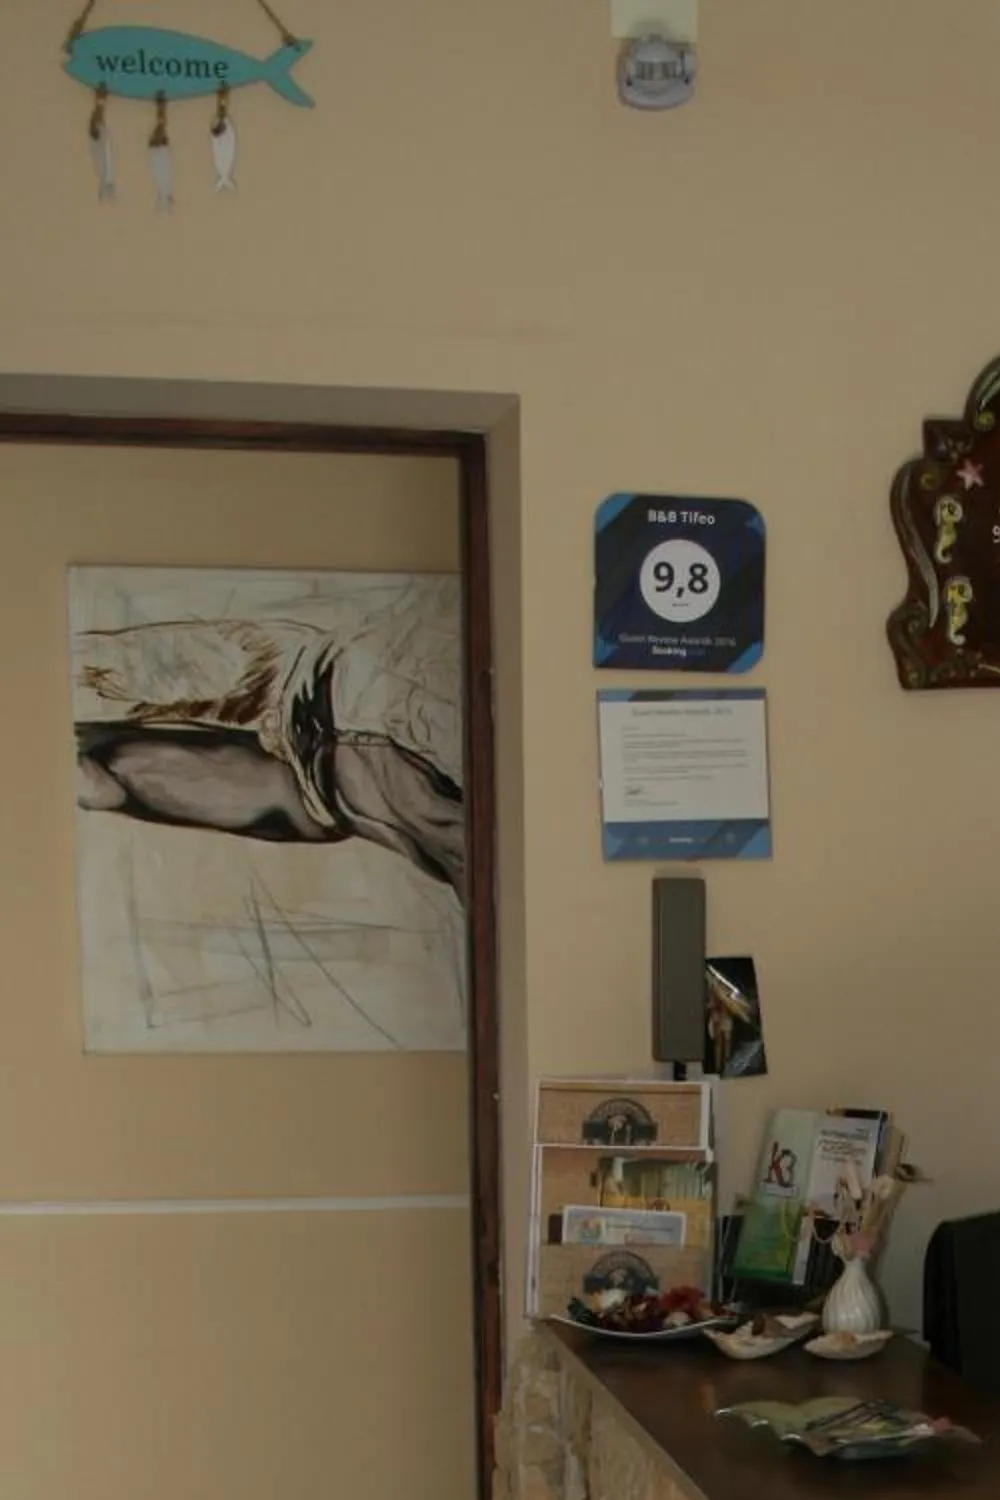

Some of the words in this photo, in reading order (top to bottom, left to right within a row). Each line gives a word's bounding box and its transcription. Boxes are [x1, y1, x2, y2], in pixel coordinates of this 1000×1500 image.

[96, 48, 229, 80] welcome
[646, 508, 677, 524] B&B
[680, 510, 716, 526] Tifeo
[653, 561, 709, 599] 9,8
